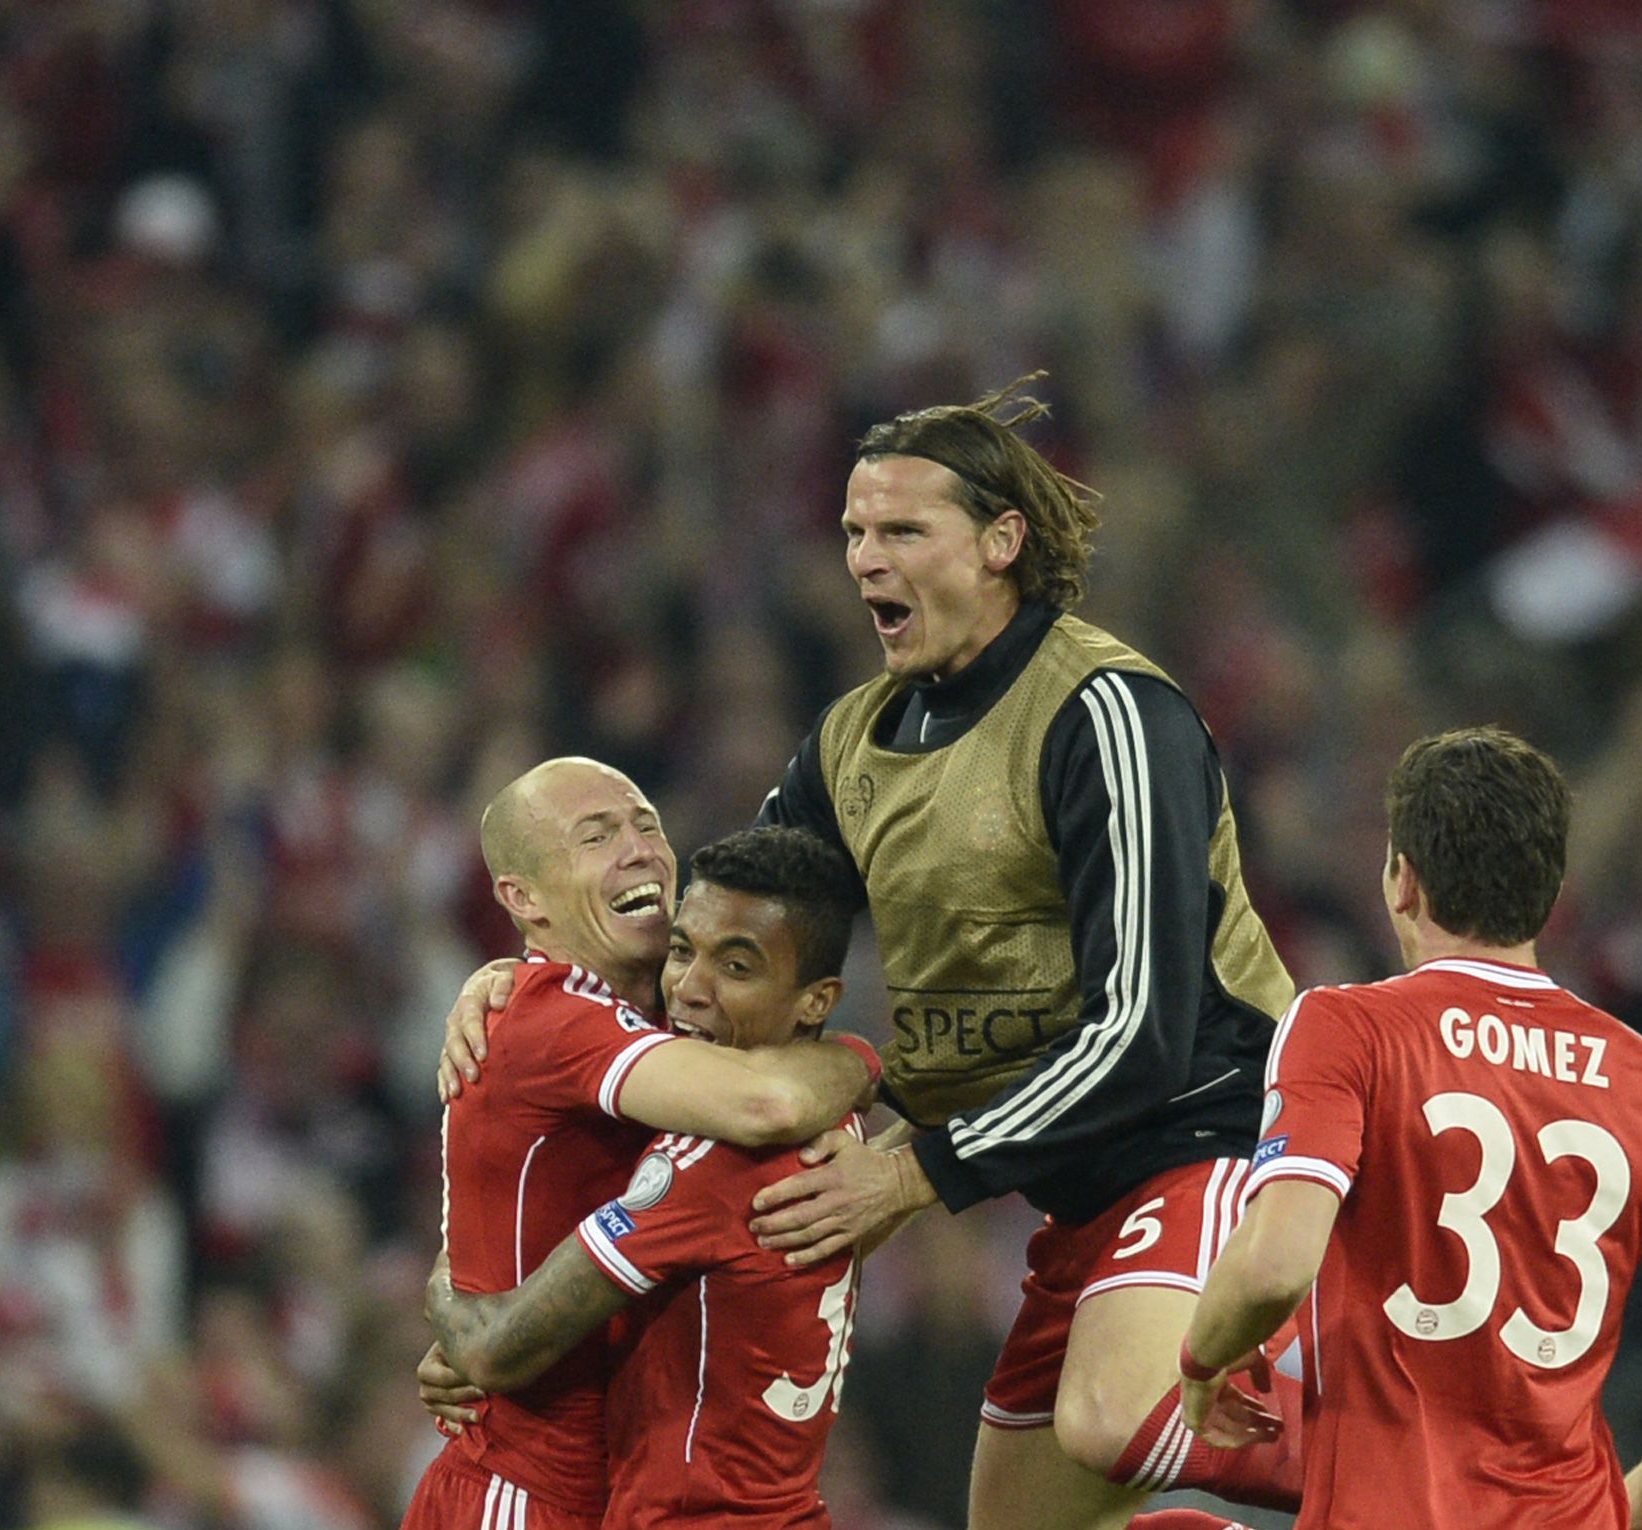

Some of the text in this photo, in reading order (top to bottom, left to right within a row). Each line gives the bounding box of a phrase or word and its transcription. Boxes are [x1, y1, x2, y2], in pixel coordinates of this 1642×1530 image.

[1439, 1007, 1609, 1088] GOMEZ
[1112, 1197, 1165, 1259] 5
[1383, 1092, 1630, 1369] 33
